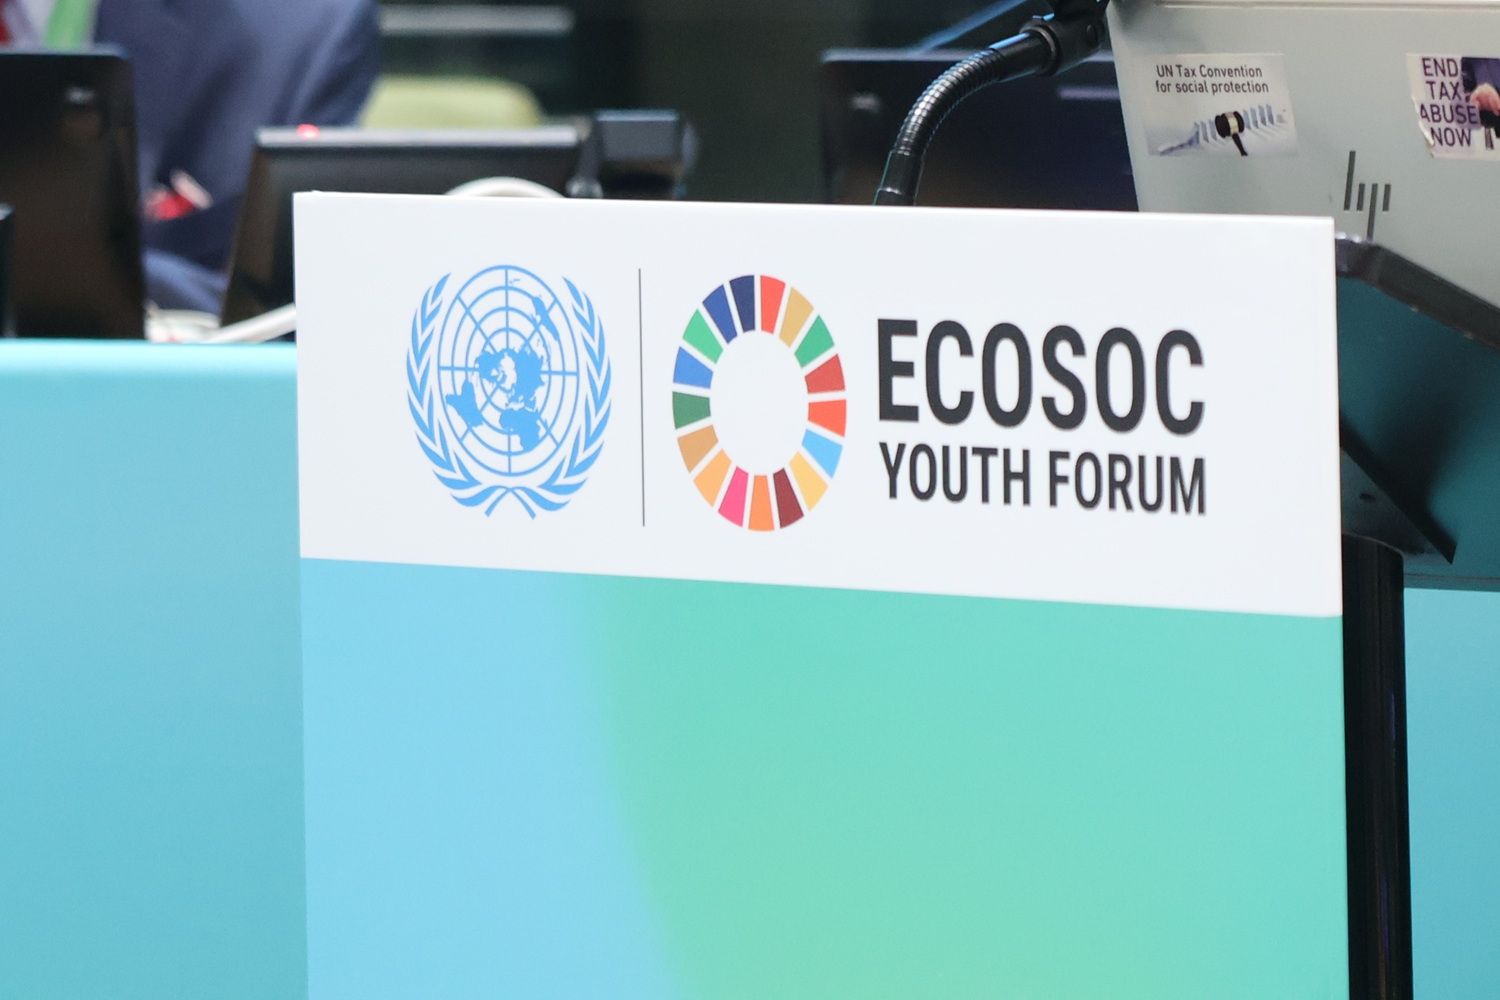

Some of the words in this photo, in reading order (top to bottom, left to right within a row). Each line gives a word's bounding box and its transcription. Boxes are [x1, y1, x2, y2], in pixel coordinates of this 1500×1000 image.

[1156, 64, 1174, 78] UN
[1175, 64, 1197, 78] Tax
[1199, 64, 1263, 78] Convention
[1422, 57, 1459, 77] END
[1155, 80, 1171, 93] for
[1175, 80, 1209, 93] social
[1211, 80, 1269, 96] protection
[1426, 81, 1462, 100] TAX
[1420, 103, 1479, 124] ABUSE
[1430, 128, 1472, 147] NOW
[877, 318, 1205, 436] ECOSOC
[878, 441, 1031, 506] YOUTH
[1048, 449, 1206, 516] FORUM
